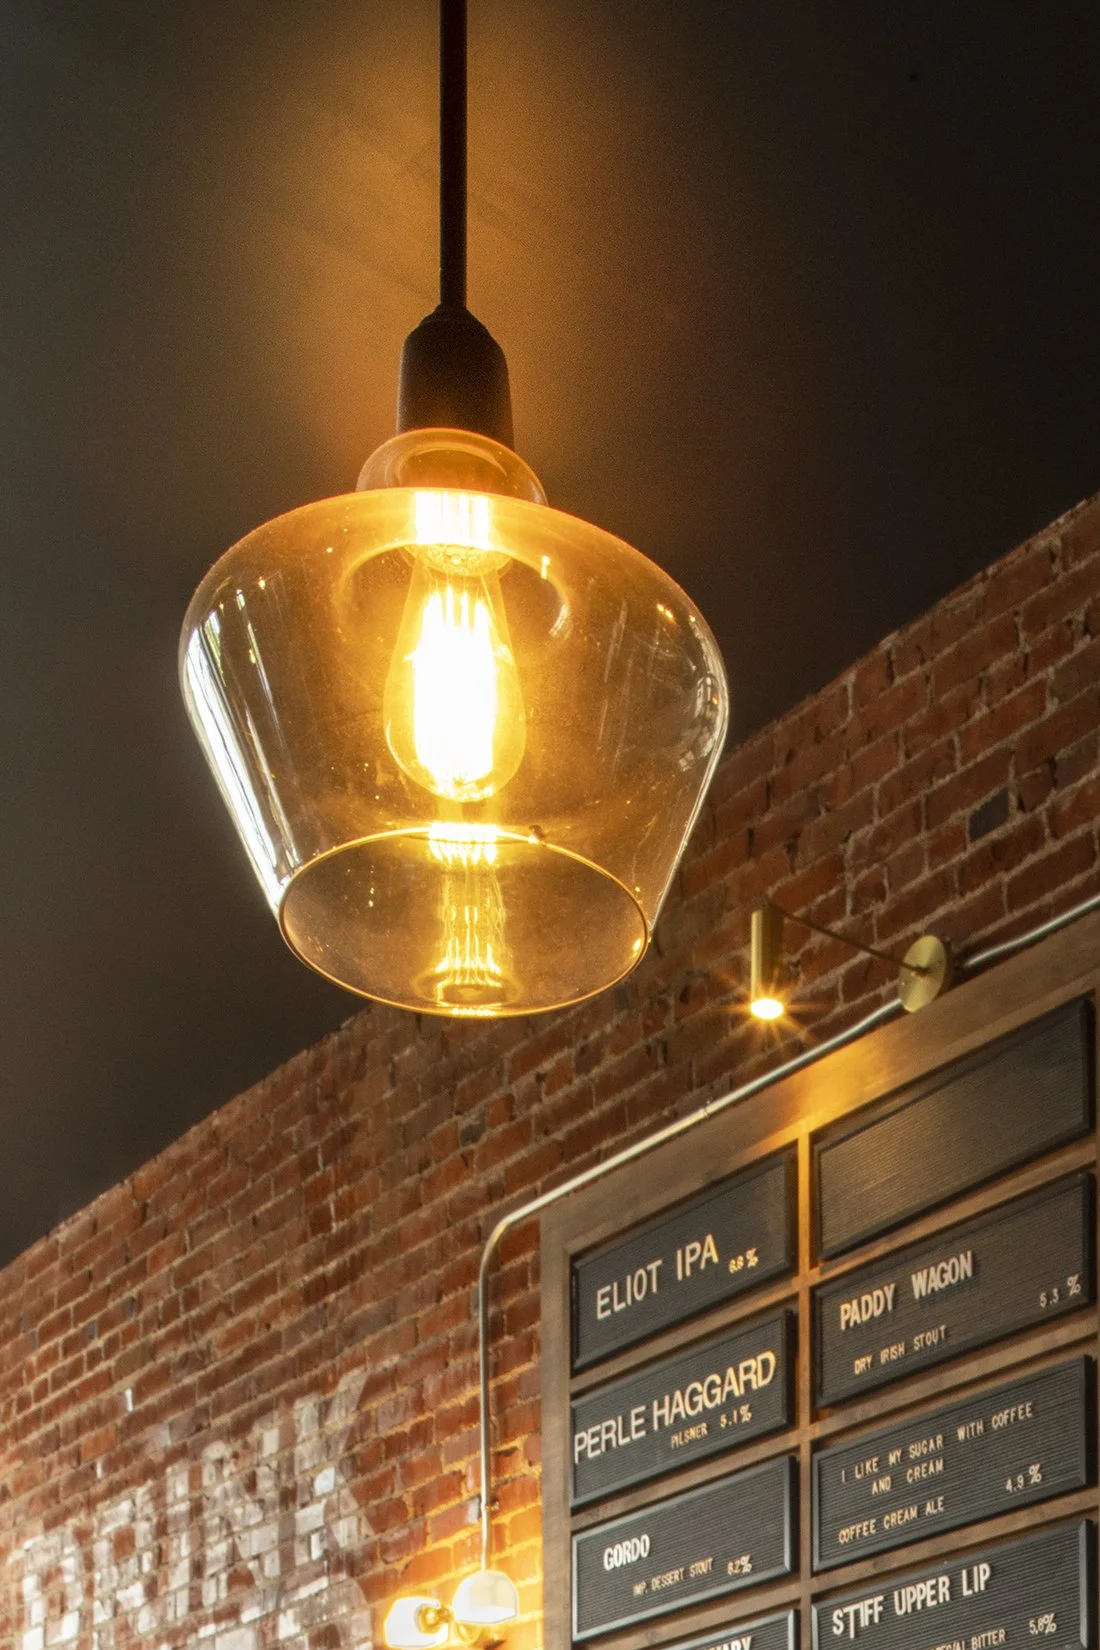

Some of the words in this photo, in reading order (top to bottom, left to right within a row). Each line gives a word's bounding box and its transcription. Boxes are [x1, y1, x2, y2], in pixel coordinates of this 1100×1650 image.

[596, 1259, 663, 1320] ELIOT
[675, 1233, 719, 1281] IPA
[839, 1282, 897, 1332] PADDY
[911, 1250, 974, 1301] WAGON
[854, 1355, 873, 1376] DRY
[880, 1342, 906, 1366] IRISH
[912, 1324, 948, 1351] STOUT
[573, 1405, 647, 1465] PERLE
[652, 1350, 777, 1432] HAGGARD
[670, 1422, 708, 1450] PILSNER
[841, 1469, 846, 1484] I
[854, 1459, 880, 1480] LIKE
[888, 1449, 903, 1466] MY
[909, 1434, 944, 1460] SUGAR
[957, 1420, 984, 1441] WITH
[991, 1401, 1034, 1430] COFFEE
[871, 1476, 892, 1496] AND
[906, 1459, 944, 1484] CREAM
[838, 1518, 877, 1545] COFFEE
[883, 1505, 918, 1530] CREAM
[924, 1495, 945, 1516] ALE
[603, 1533, 651, 1572] GORDO
[651, 1567, 685, 1592] DESSERT
[689, 1557, 714, 1579] STOUT
[831, 1594, 885, 1640] STIFF
[893, 1574, 951, 1617] UPPER
[961, 1562, 992, 1597] LIP
